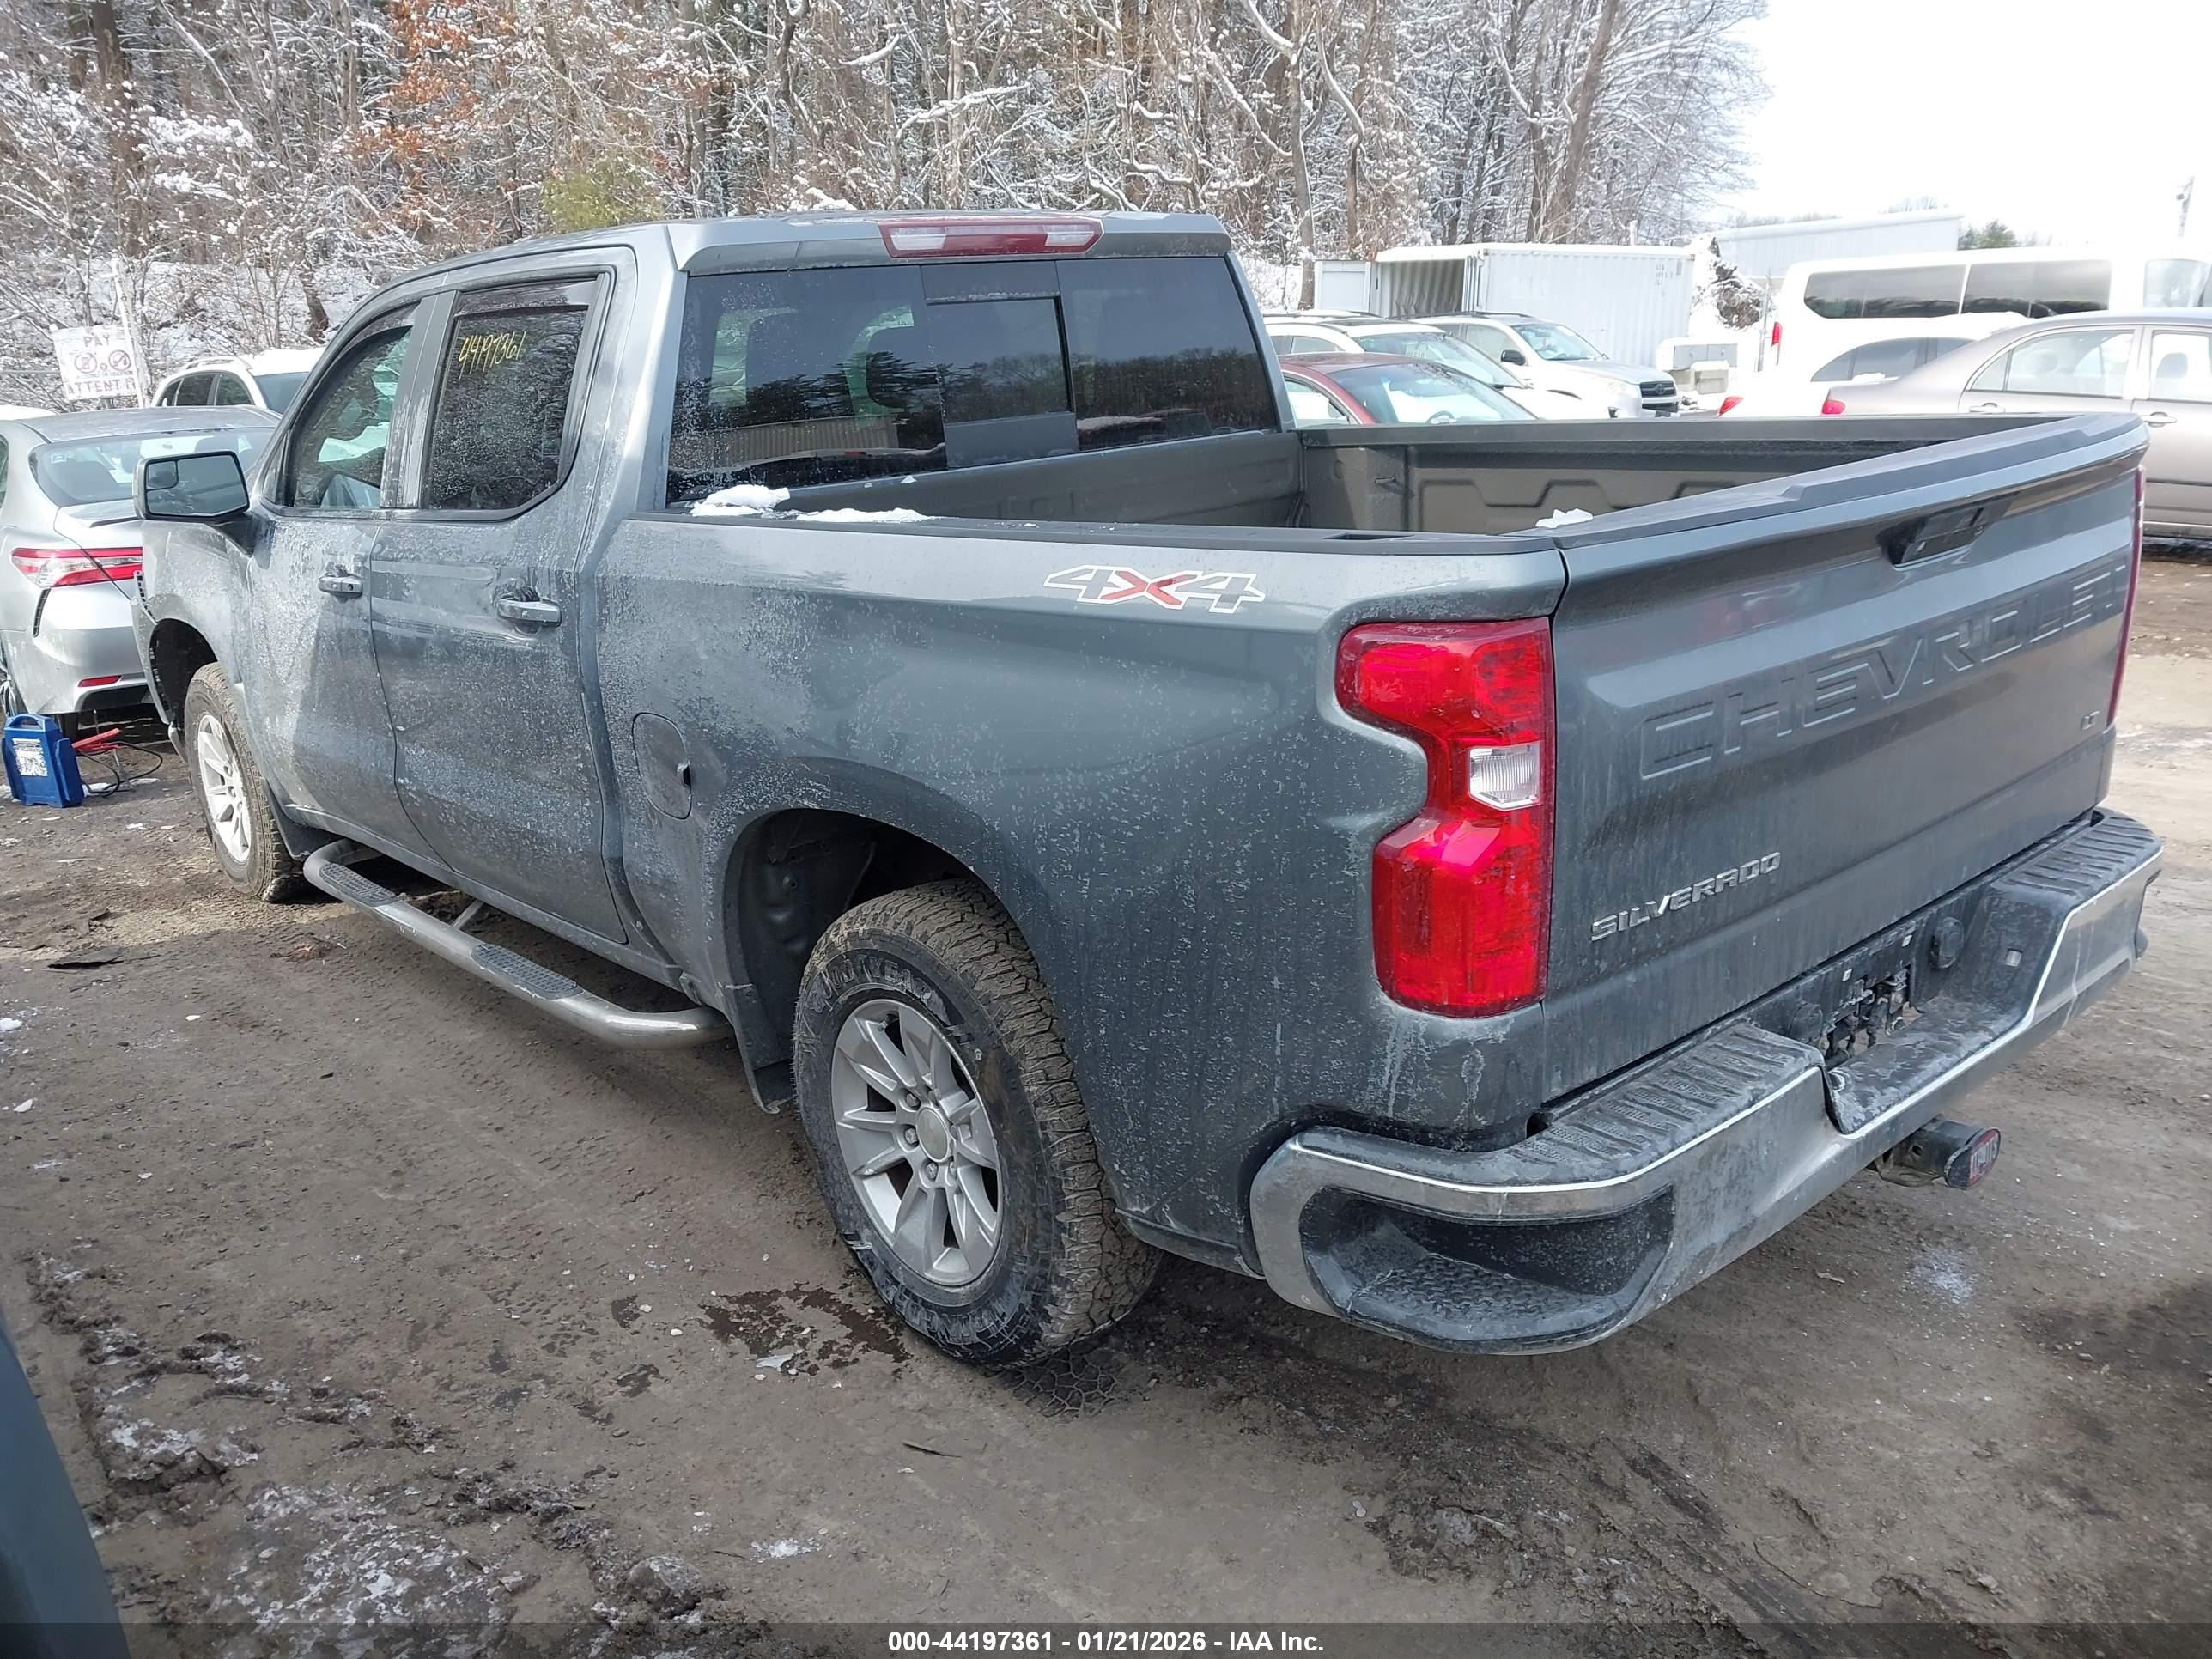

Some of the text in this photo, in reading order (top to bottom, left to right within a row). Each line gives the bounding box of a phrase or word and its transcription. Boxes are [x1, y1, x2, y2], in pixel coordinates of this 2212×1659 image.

[83, 332, 111, 347] PAY
[458, 331, 526, 380] 44197361
[1639, 560, 2128, 781] CHEVROLET
[1590, 851, 1781, 942] SILVERADO
